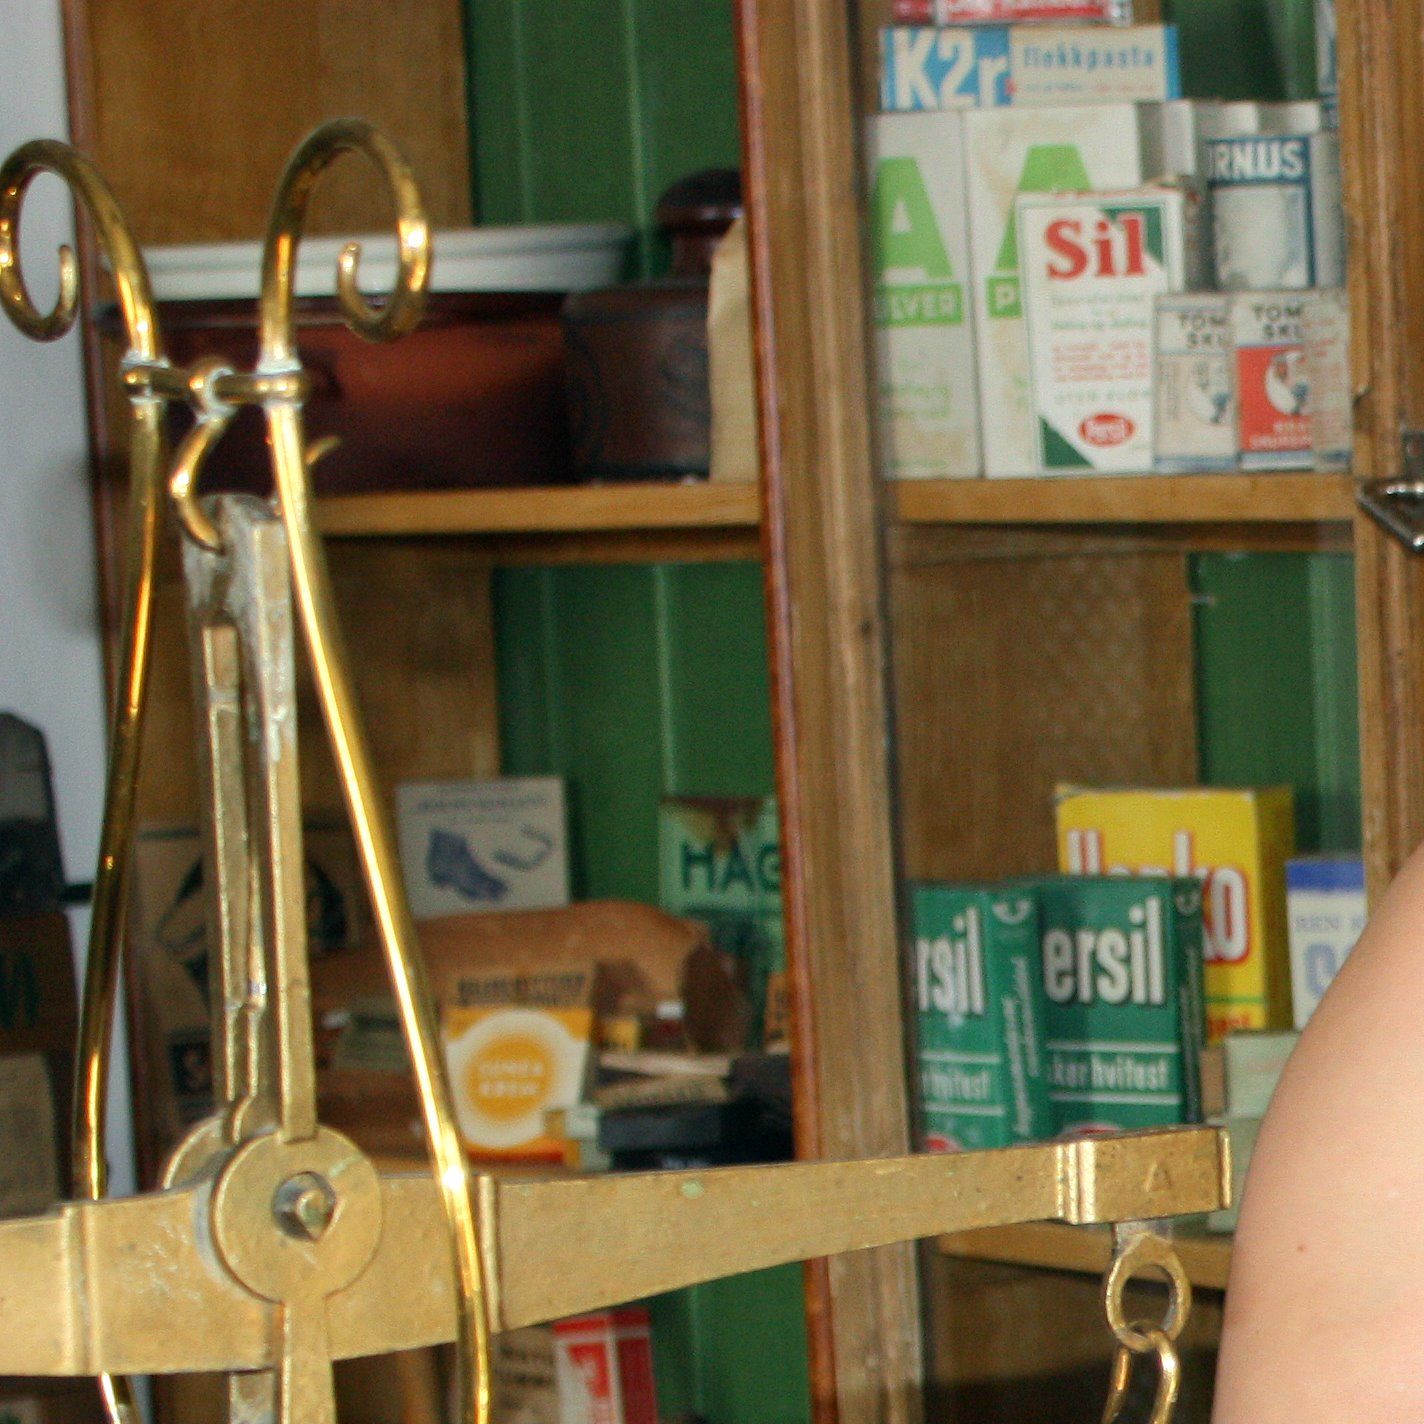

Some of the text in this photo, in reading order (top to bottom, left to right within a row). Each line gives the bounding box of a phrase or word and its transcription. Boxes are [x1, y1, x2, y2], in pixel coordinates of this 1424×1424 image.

[892, 27, 1008, 110] K2r
[1045, 214, 1147, 282] Sil
[1043, 895, 1165, 1006] ersil
